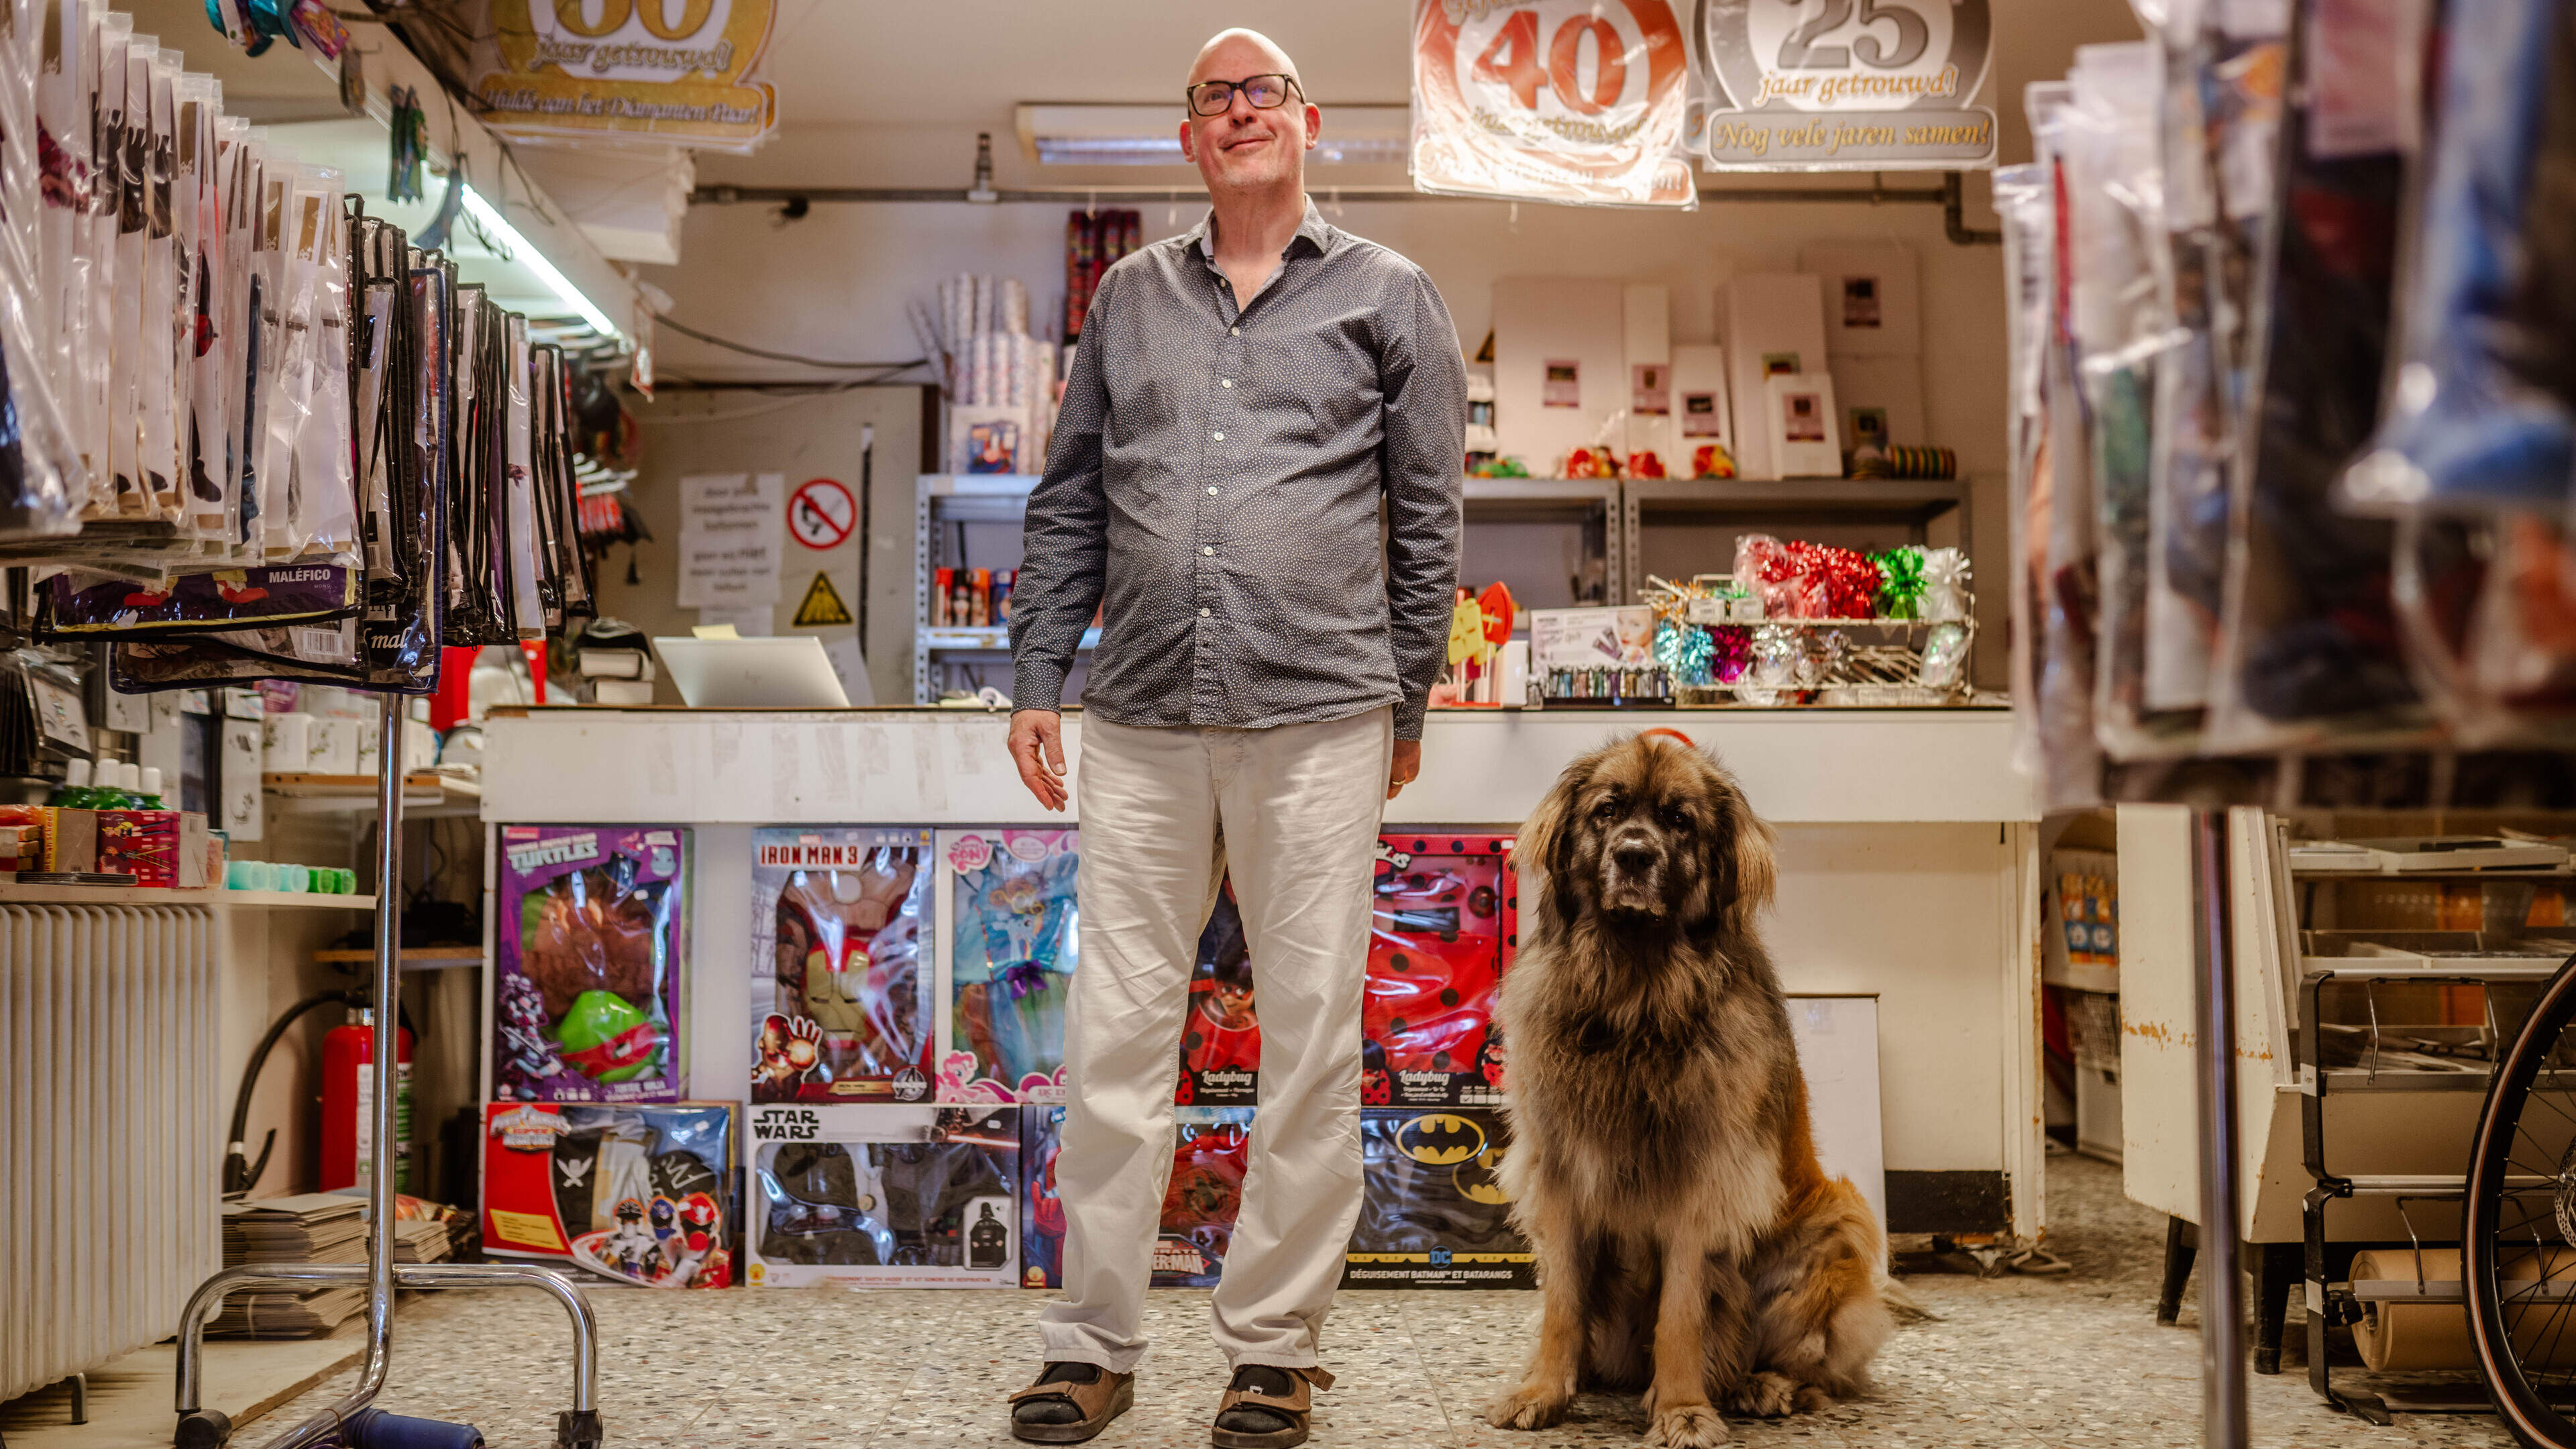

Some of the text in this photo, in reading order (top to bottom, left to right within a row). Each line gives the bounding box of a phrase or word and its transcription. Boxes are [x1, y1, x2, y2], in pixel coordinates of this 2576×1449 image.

[1777, 0, 1929, 68] 25
[1471, 10, 1626, 115] 40
[1756, 68, 1957, 105] jaar getrouwd!
[1715, 122, 1770, 155] Nog
[1778, 119, 1825, 146] vele
[1827, 123, 1896, 155] jaren
[1902, 119, 1990, 145] samen!
[268, 568, 331, 584] MALÉFICO
[507, 841, 599, 871] TURTLES
[761, 845, 858, 865] IRON MAN 3
[1201, 1070, 1253, 1086] Ladybug
[1398, 1069, 1450, 1086] Ladybug
[753, 1110, 820, 1124] STAR
[753, 1125, 820, 1140] WARS
[1430, 1250, 1452, 1265] DC
[1350, 1268, 1410, 1279] DÉGUISEMENT
[1452, 1270, 1463, 1279] ET
[1463, 1270, 1513, 1279] BATARANGS
